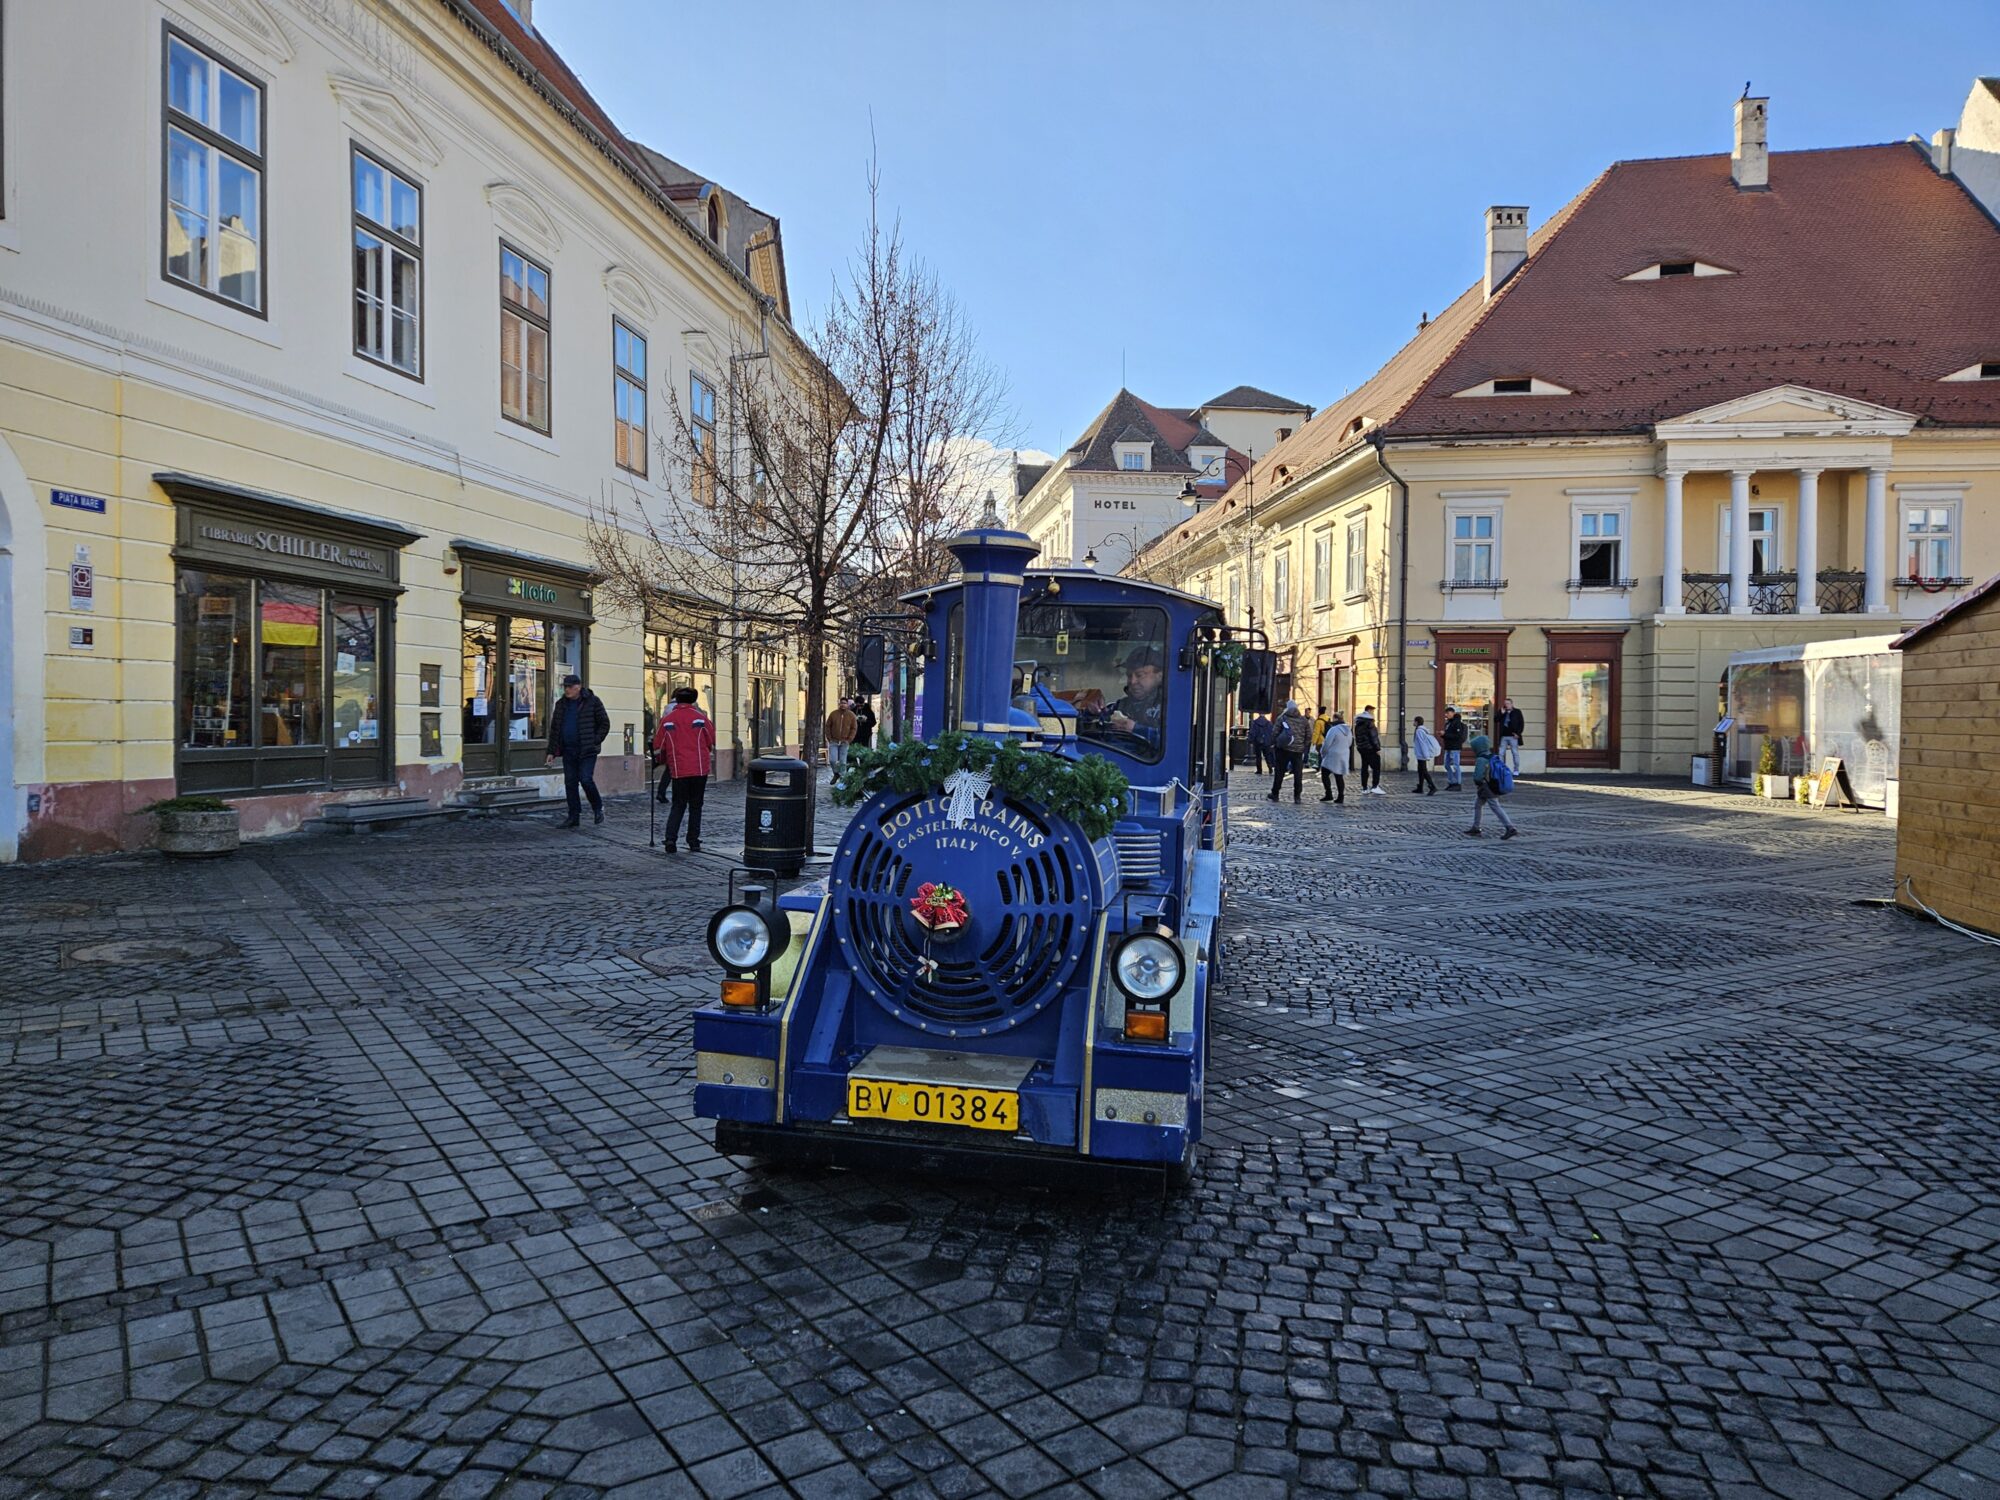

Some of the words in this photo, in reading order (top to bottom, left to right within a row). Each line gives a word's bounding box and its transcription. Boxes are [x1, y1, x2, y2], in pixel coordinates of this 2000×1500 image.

[81, 496, 99, 508] MARE
[1094, 500, 1136, 510] HOTEL
[255, 531, 343, 564] SCHILLER
[1452, 647, 1491, 655] FARMACIE
[880, 796, 954, 840] DOTTO
[971, 797, 1044, 849] RAINS
[935, 837, 978, 852] ITALY
[855, 1085, 893, 1114] BV
[914, 1090, 1008, 1125] 01384
